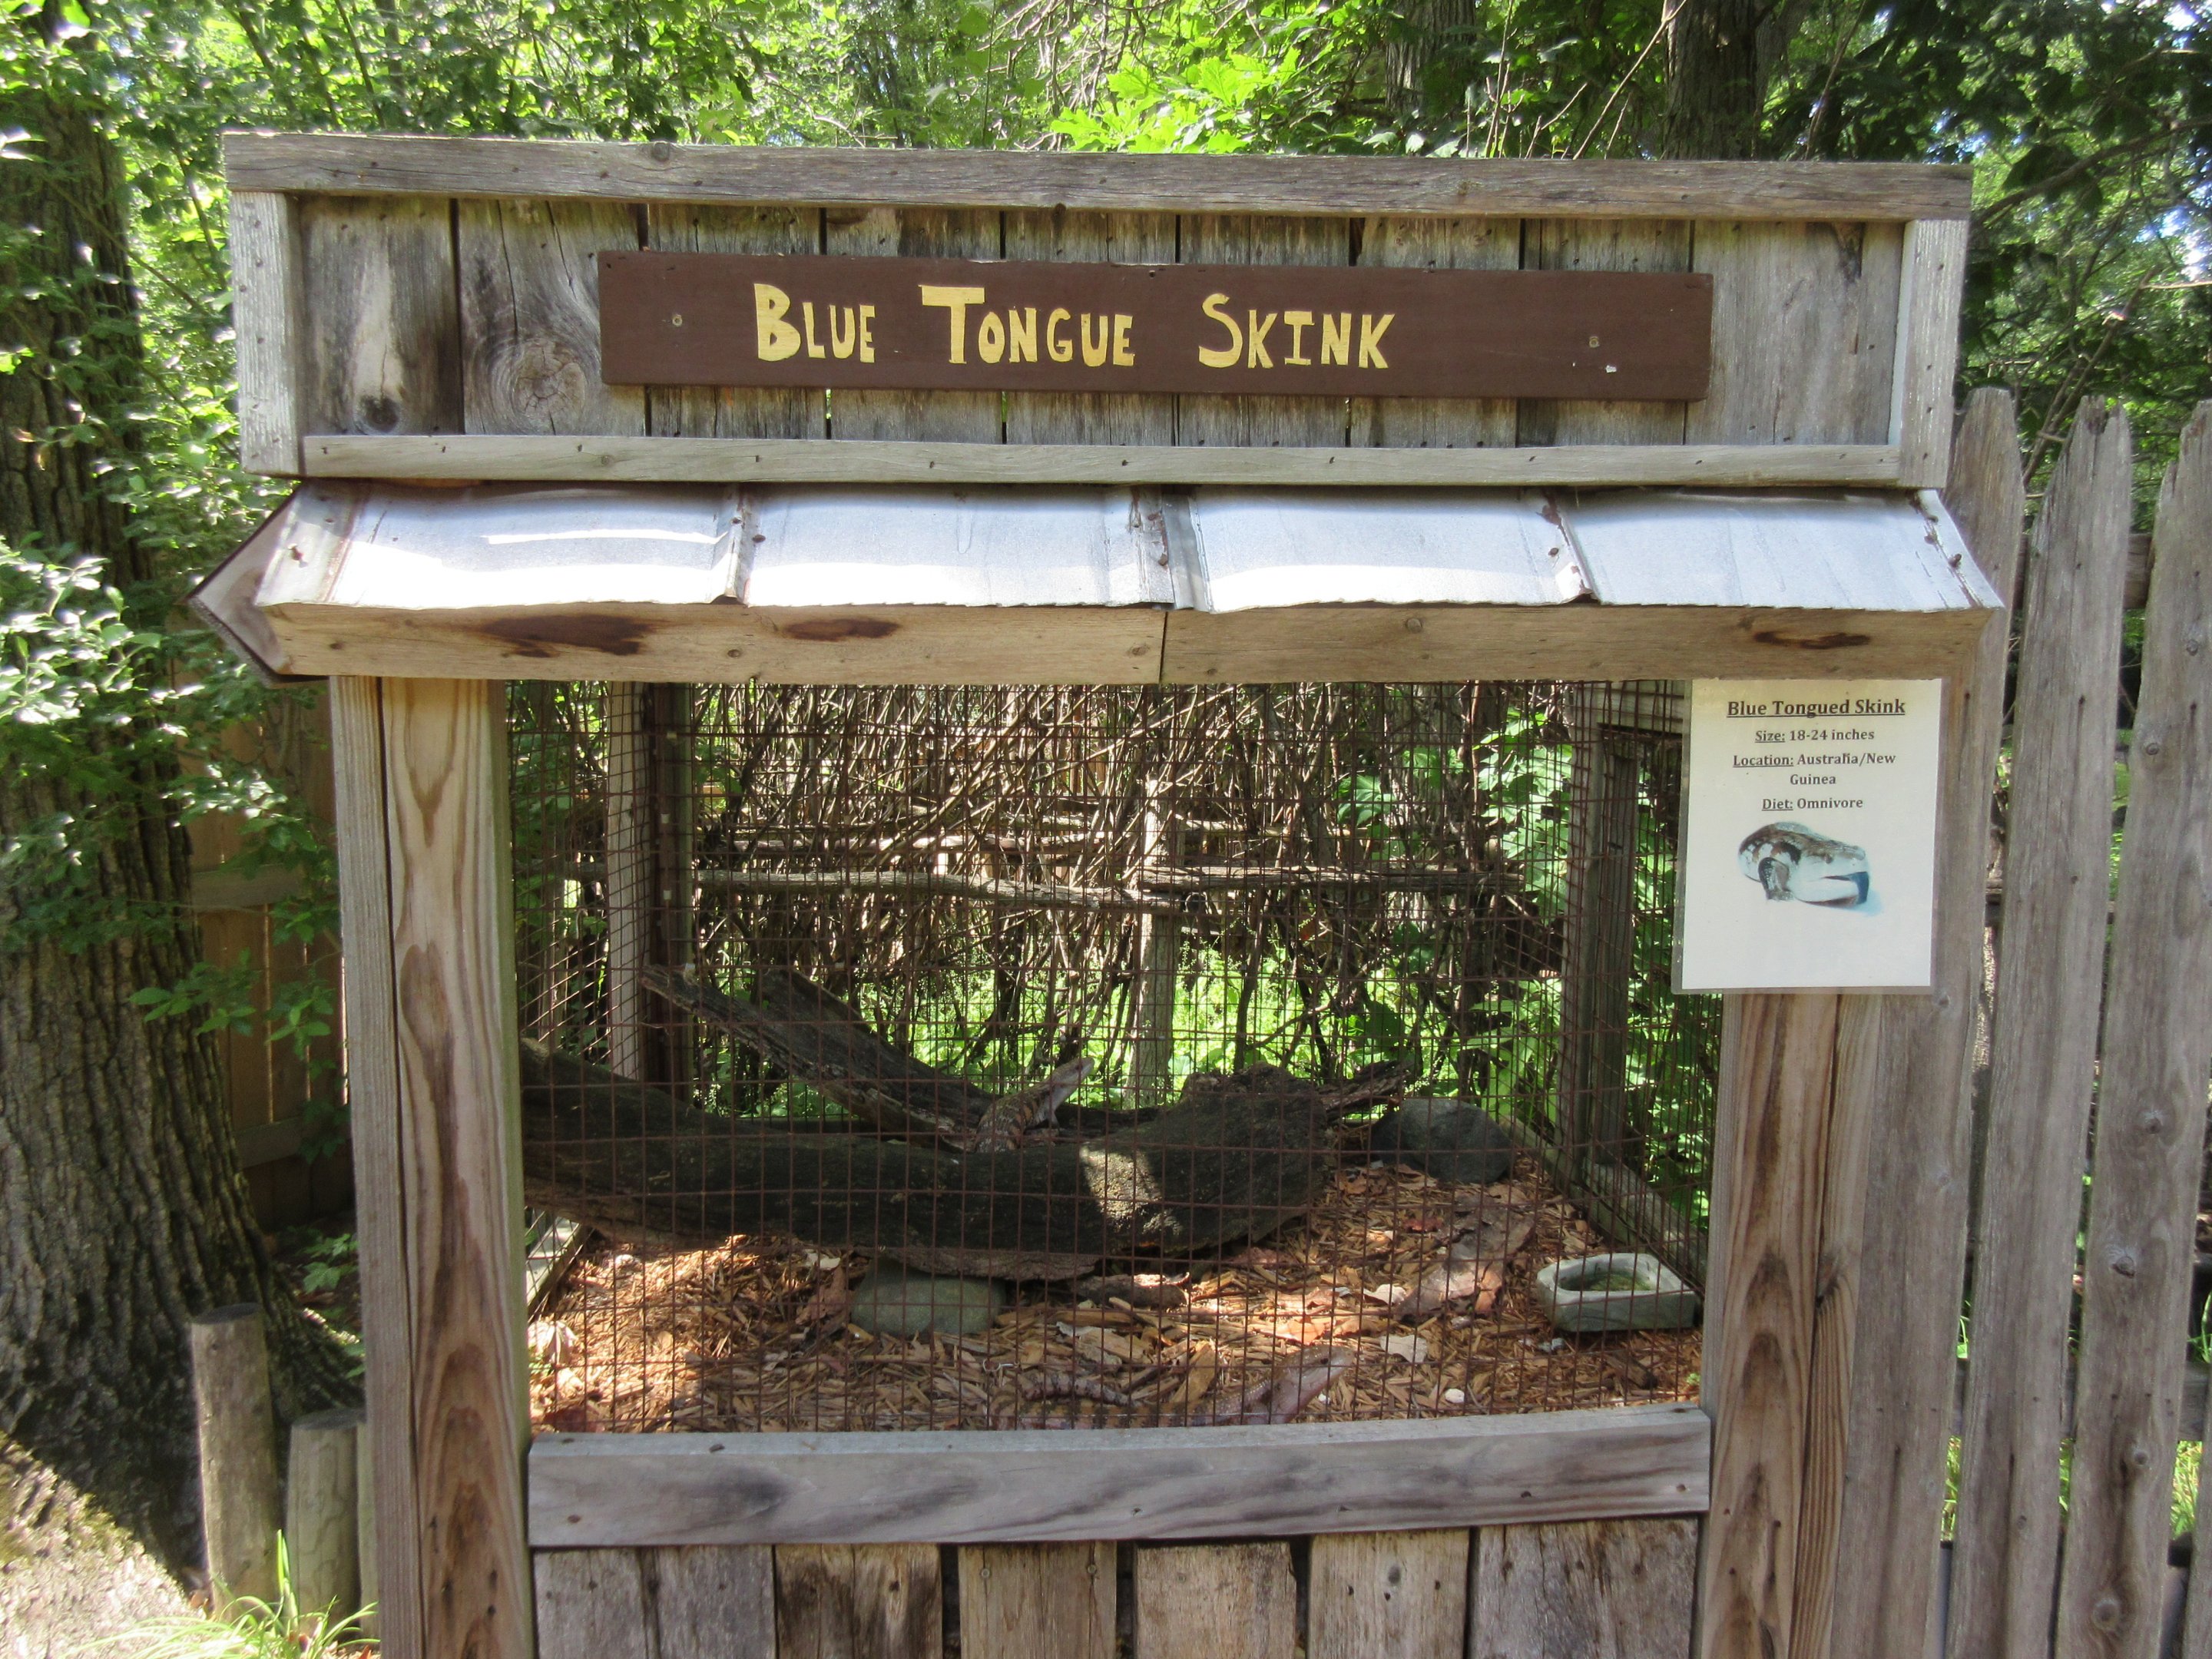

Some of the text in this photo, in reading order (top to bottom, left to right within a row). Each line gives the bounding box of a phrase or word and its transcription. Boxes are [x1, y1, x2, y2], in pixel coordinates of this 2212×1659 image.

[753, 283, 1396, 371] BLUE TONGUE SKINK
[1727, 699, 1906, 718] Blue Tongued Skink
[1755, 729, 1875, 743] Size: 18-24 inches
[1733, 753, 1896, 767] Location: Australia/New
[1790, 774, 1836, 785] Guinea
[1762, 797, 1863, 811] Diet: Omnivore
